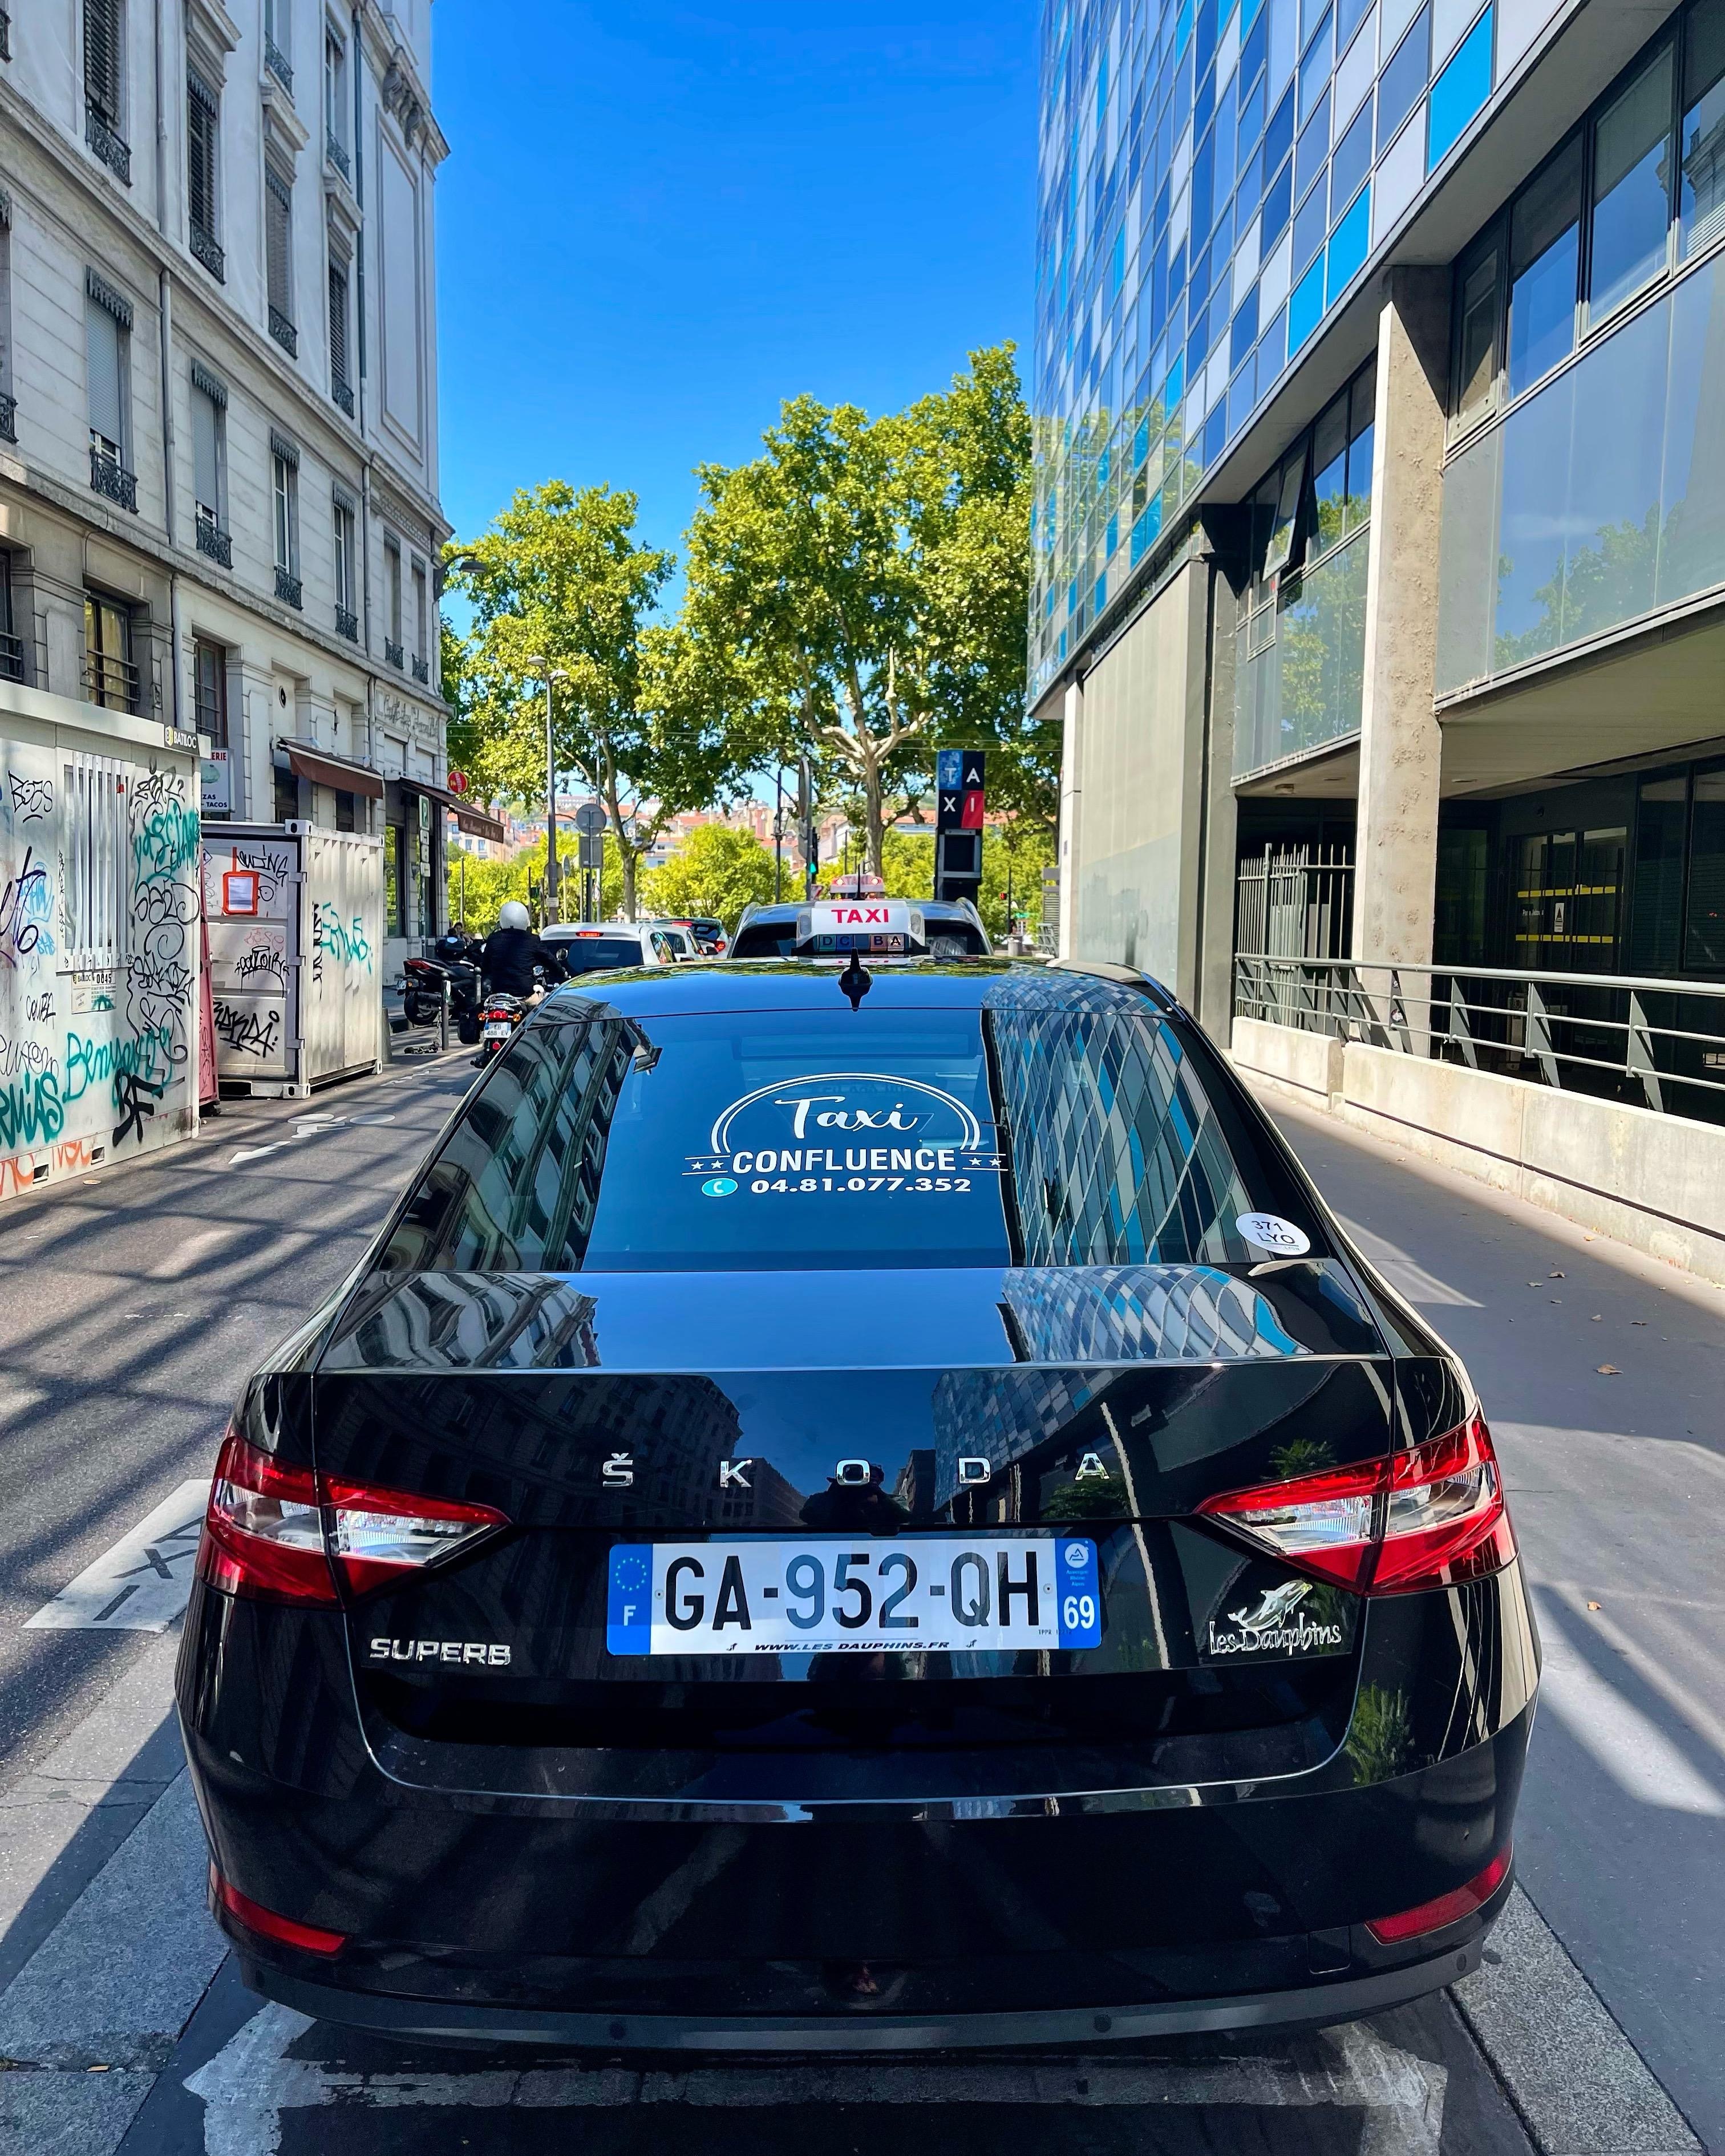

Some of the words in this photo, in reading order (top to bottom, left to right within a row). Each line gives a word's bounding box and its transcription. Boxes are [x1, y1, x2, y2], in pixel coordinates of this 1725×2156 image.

[173, 730, 197, 749] BATILOC
[211, 752, 227, 761] ERIE
[831, 909, 889, 923] TAXI
[774, 1095, 918, 1140] Taxi
[732, 1148, 957, 1174] CONFLUENCE
[750, 1177, 971, 1194] 04.81.077.352
[1251, 1220, 1283, 1231] 371
[1257, 1232, 1295, 1244] LYO
[623, 1604, 637, 1627] F
[665, 1551, 1040, 1631] GA-952-QH
[1063, 1595, 1095, 1630] 69
[369, 1638, 512, 1665] SUPERB
[754, 1643, 833, 1651] WWW.LES
[837, 1641, 950, 1651] DAUPHINS.FR
